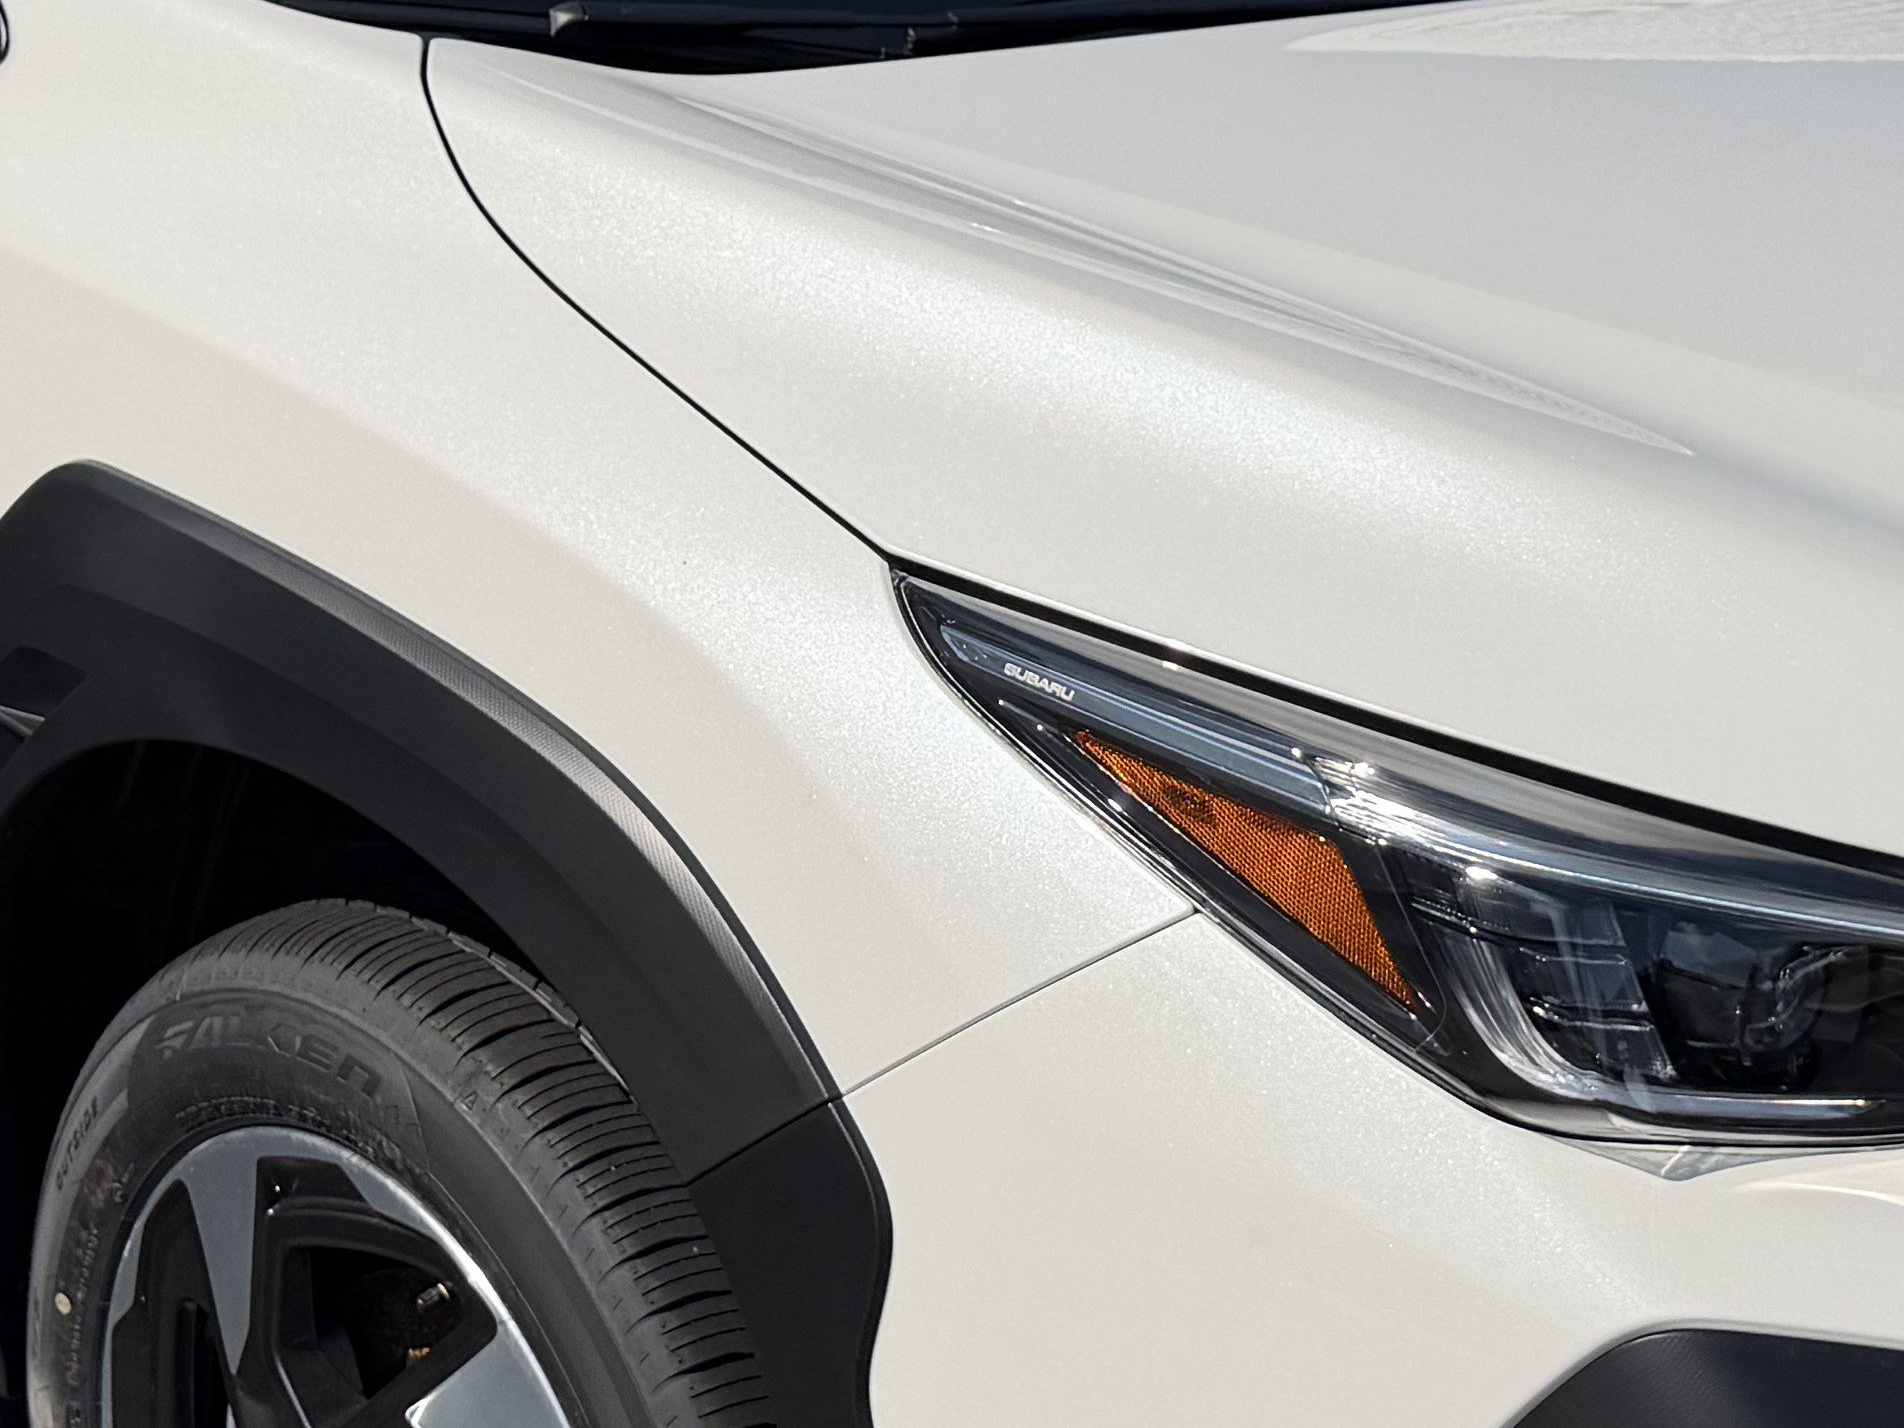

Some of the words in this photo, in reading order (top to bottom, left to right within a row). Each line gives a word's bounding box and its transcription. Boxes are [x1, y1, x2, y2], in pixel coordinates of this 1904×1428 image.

[1003, 662, 1076, 702] SUBARU
[154, 1014, 383, 1101] FALKEN
[54, 1094, 98, 1192] OUTSIDE
